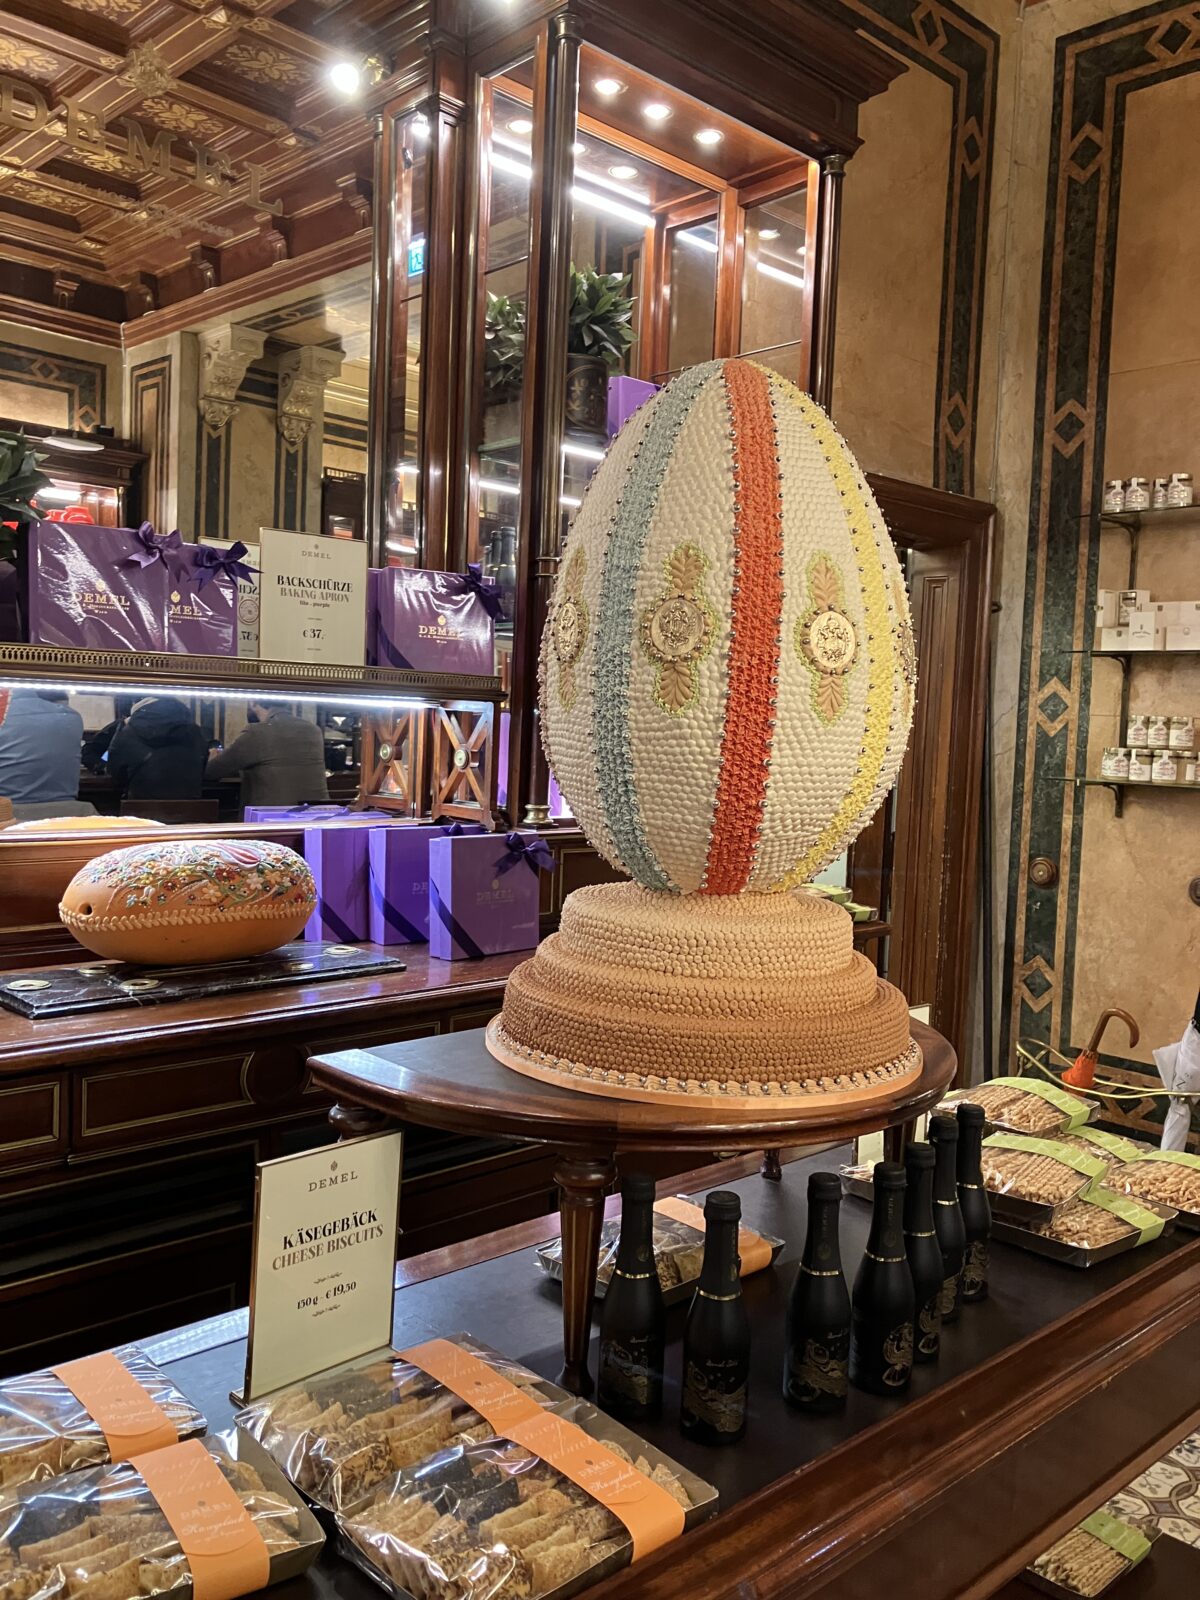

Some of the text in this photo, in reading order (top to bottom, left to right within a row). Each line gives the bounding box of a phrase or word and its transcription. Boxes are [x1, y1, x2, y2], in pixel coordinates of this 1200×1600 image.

[0, 75, 283, 217] DEMEL
[301, 550, 332, 560] DEMEL
[277, 574, 354, 593] BACKSCHÜRZE
[280, 587, 350, 604] BAKING APRON
[302, 628, 309, 638] €
[307, 1170, 359, 1193] DEMEL
[282, 1207, 378, 1251] KÄSEGEBÄCK
[272, 1223, 384, 1271] CHEESE BISCUITS
[325, 1290, 332, 1300] €
[333, 1281, 357, 1298] 19,50
